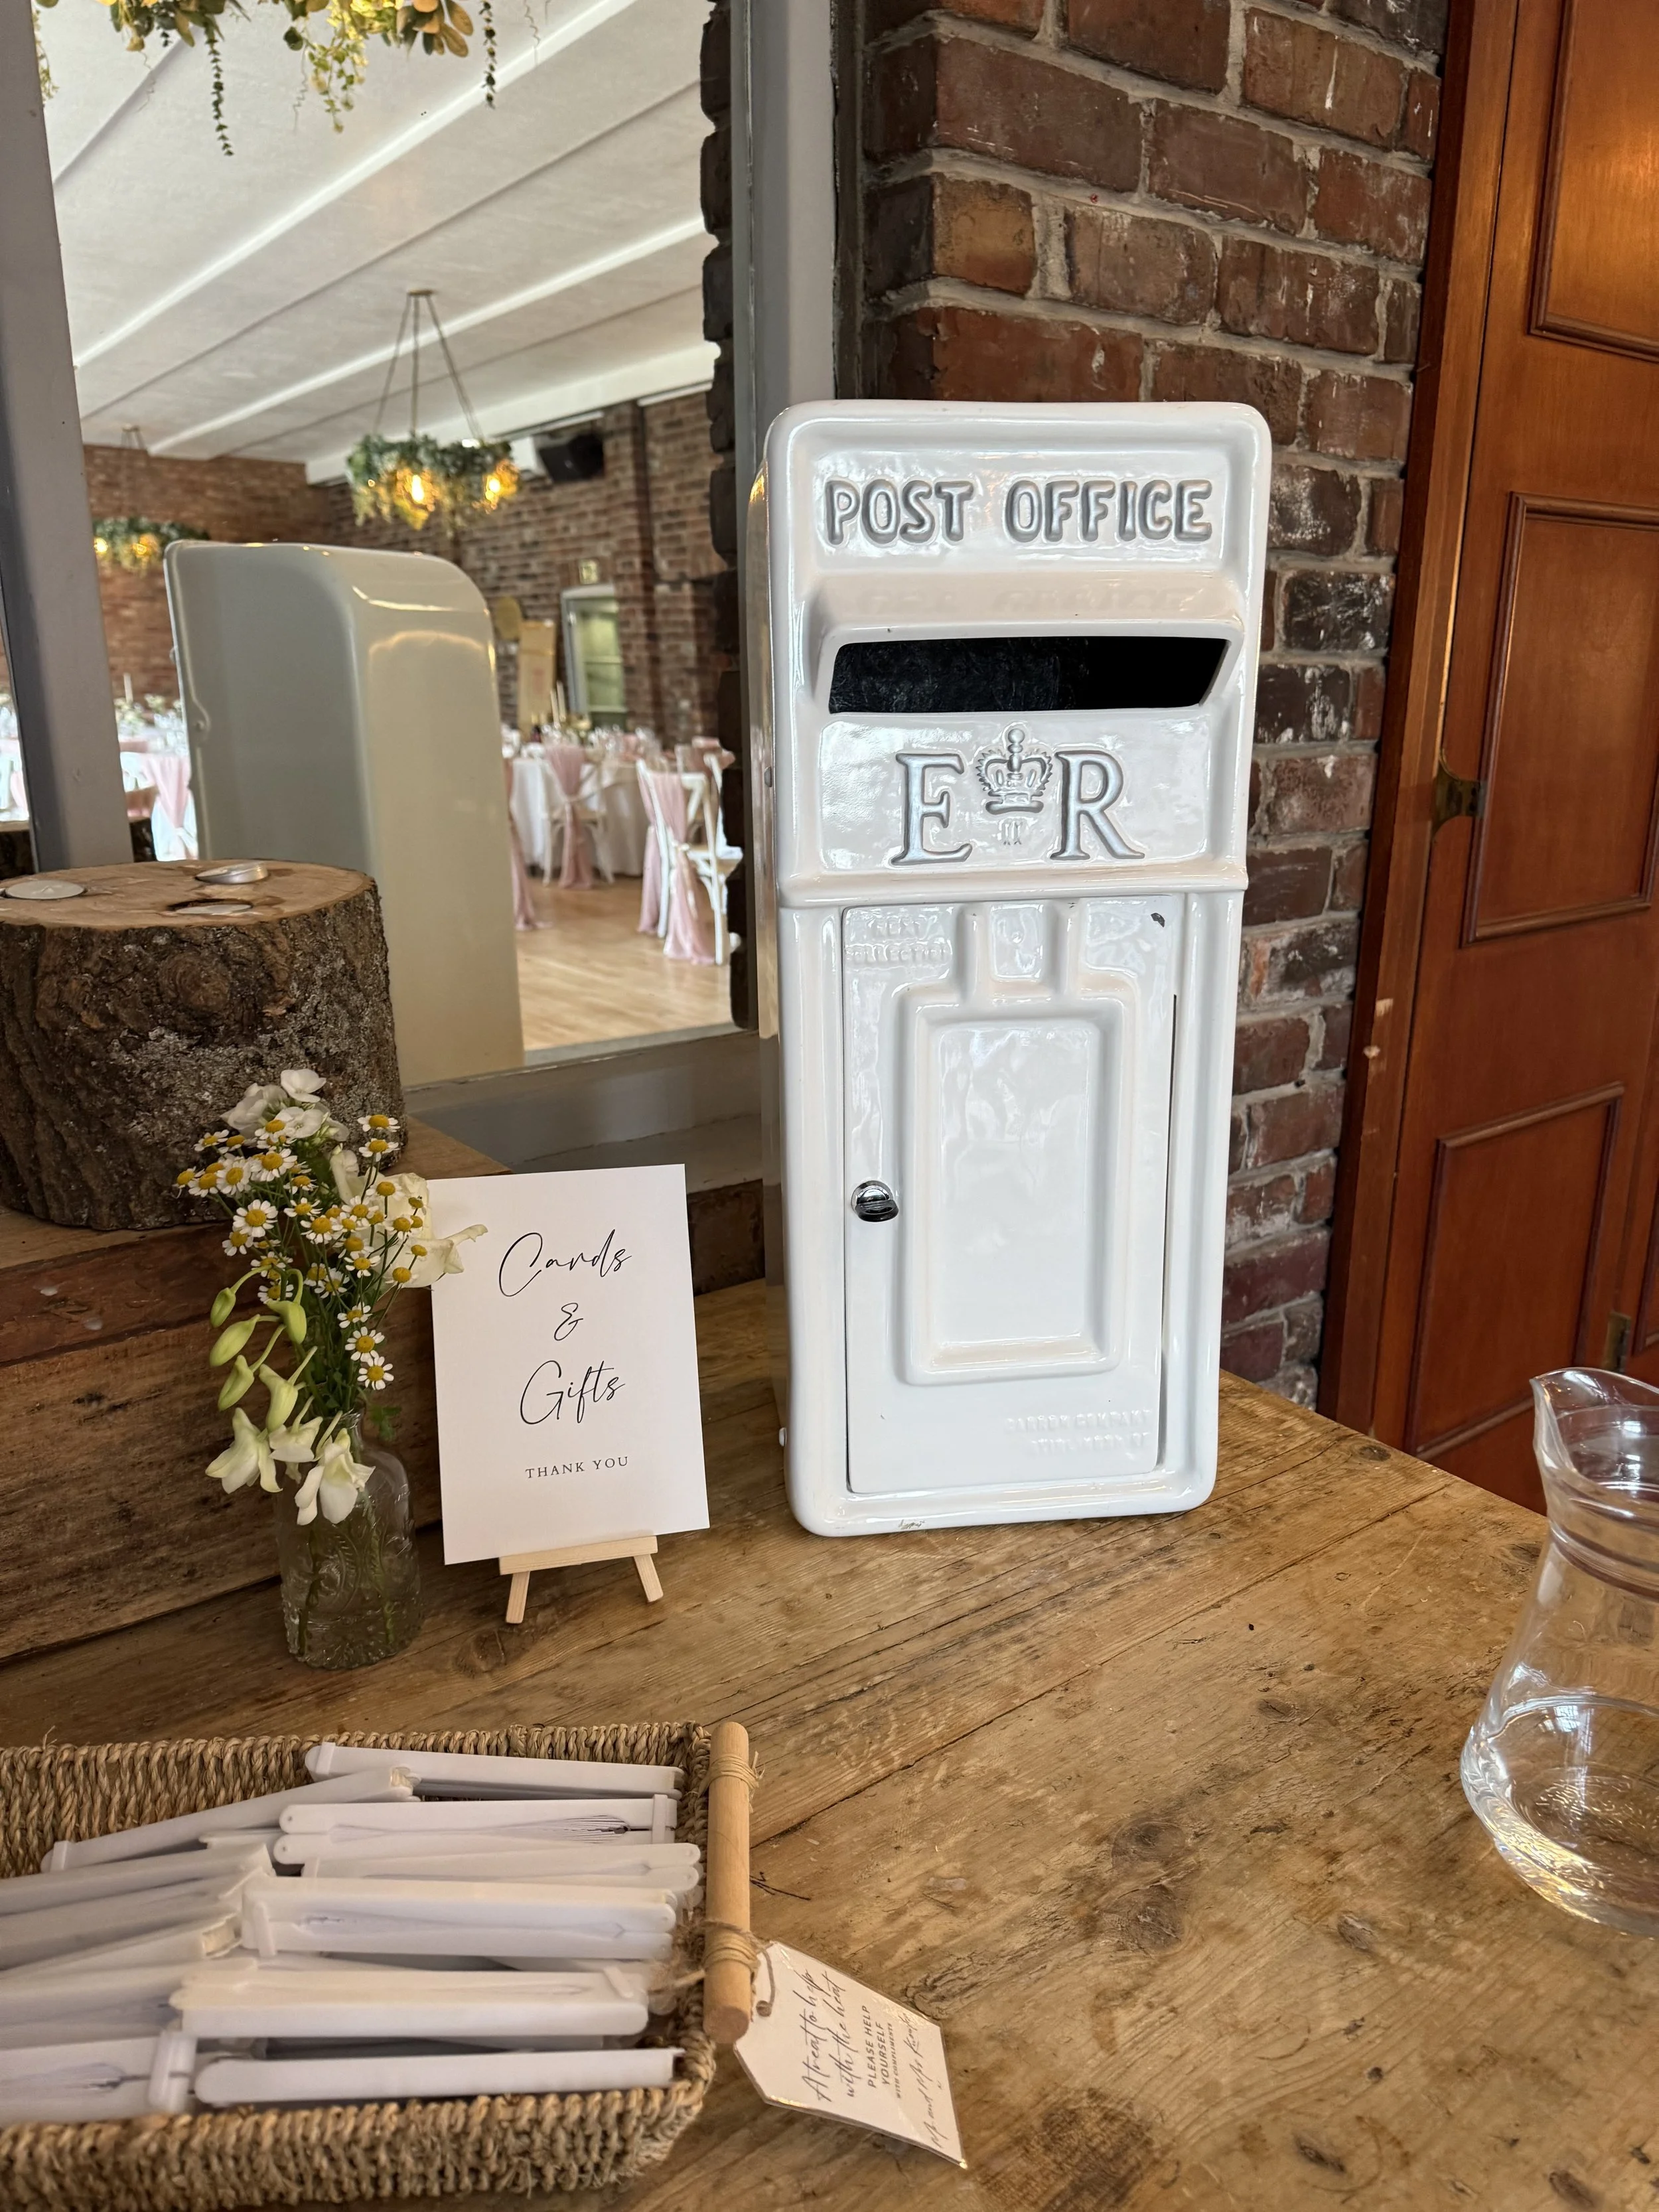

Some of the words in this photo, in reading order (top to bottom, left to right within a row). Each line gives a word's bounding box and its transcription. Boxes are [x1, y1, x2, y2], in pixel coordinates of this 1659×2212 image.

[824, 479, 974, 546] POST
[1003, 479, 1212, 543] OFFICE
[891, 753, 973, 865] E
[1050, 750, 1145, 861] R
[499, 1229, 632, 1297] Cards
[553, 1302, 584, 1341] &
[520, 1360, 626, 1425] Gifts
[525, 1461, 585, 1479] THANK
[591, 1456, 629, 1470] YOU
[793, 1969, 831, 2007] help
[822, 1970, 846, 2018] heat
[799, 2008, 827, 2031] to
[826, 2022, 859, 2053] the
[862, 2006, 873, 2037] HELP
[800, 2024, 830, 2078] treat
[865, 2039, 877, 2088] PLEASE
[875, 2022, 890, 2085] YOURSELF
[887, 2023, 901, 2076] COMPLIMENTS
[802, 2075, 832, 2102] A
[828, 2053, 862, 2098] with
